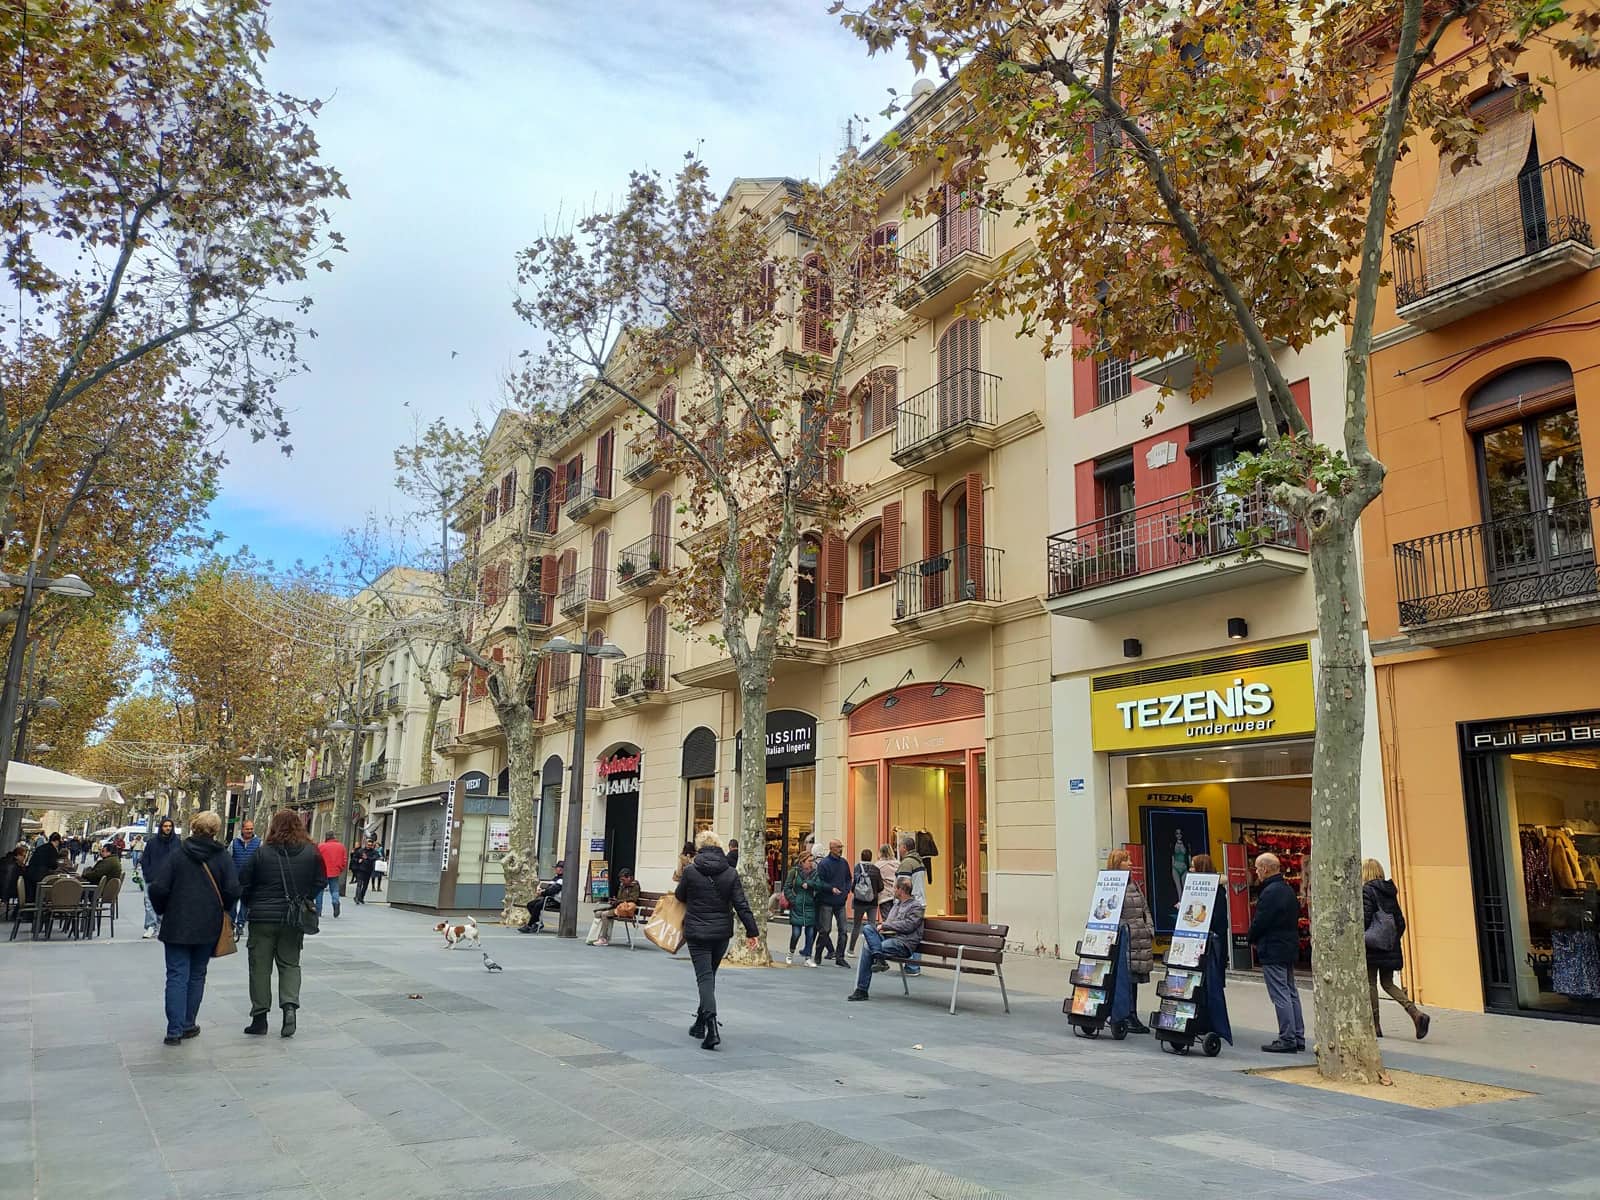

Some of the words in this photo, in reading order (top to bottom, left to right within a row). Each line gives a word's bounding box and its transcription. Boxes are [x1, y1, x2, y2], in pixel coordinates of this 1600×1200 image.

[1186, 719, 1275, 737] underwear
[1474, 732, 1516, 747] Pull
[1521, 730, 1567, 744] and
[786, 741, 811, 754] lingerie
[596, 777, 640, 796] DIANA
